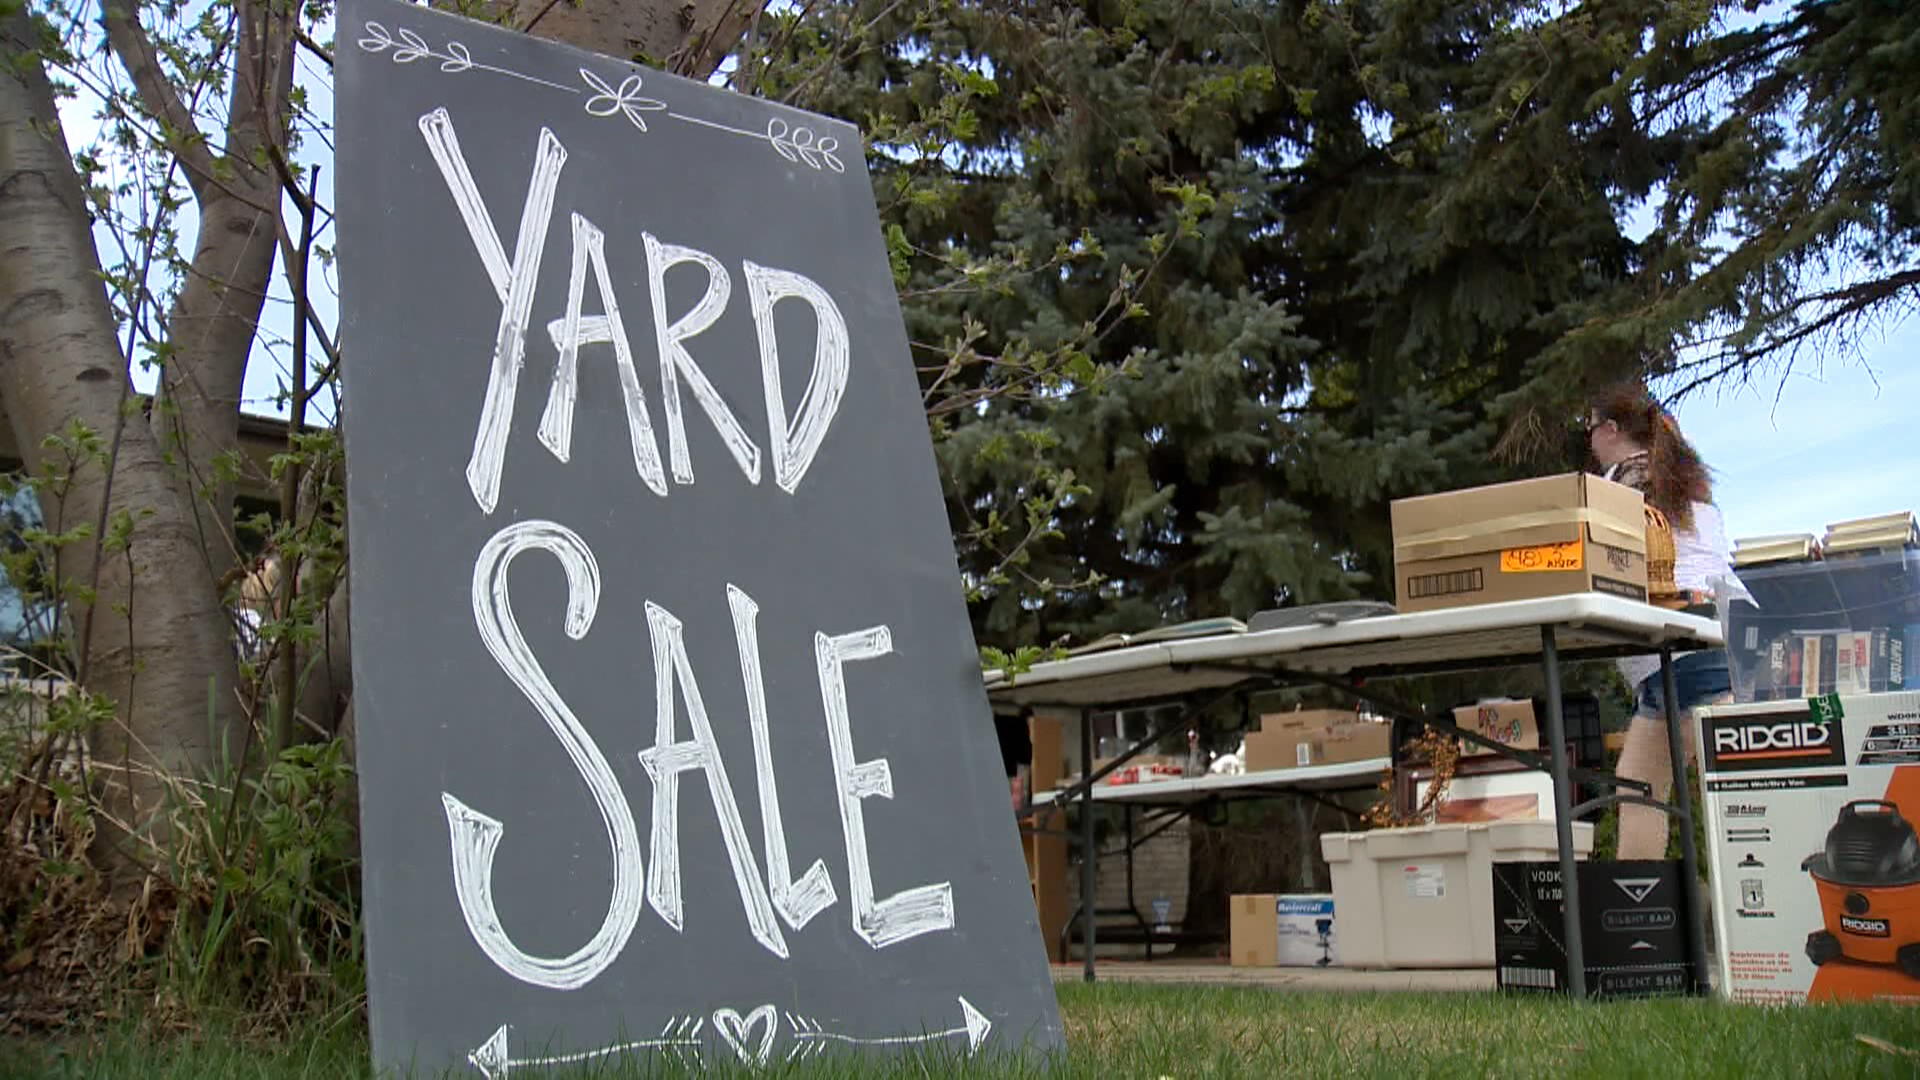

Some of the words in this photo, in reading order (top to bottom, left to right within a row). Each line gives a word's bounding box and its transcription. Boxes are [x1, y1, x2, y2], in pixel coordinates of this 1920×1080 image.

[419, 107, 850, 515] YARD
[442, 520, 955, 990] SALE
[1713, 722, 1830, 752] RIDGID
[1531, 870, 1562, 882] VODK
